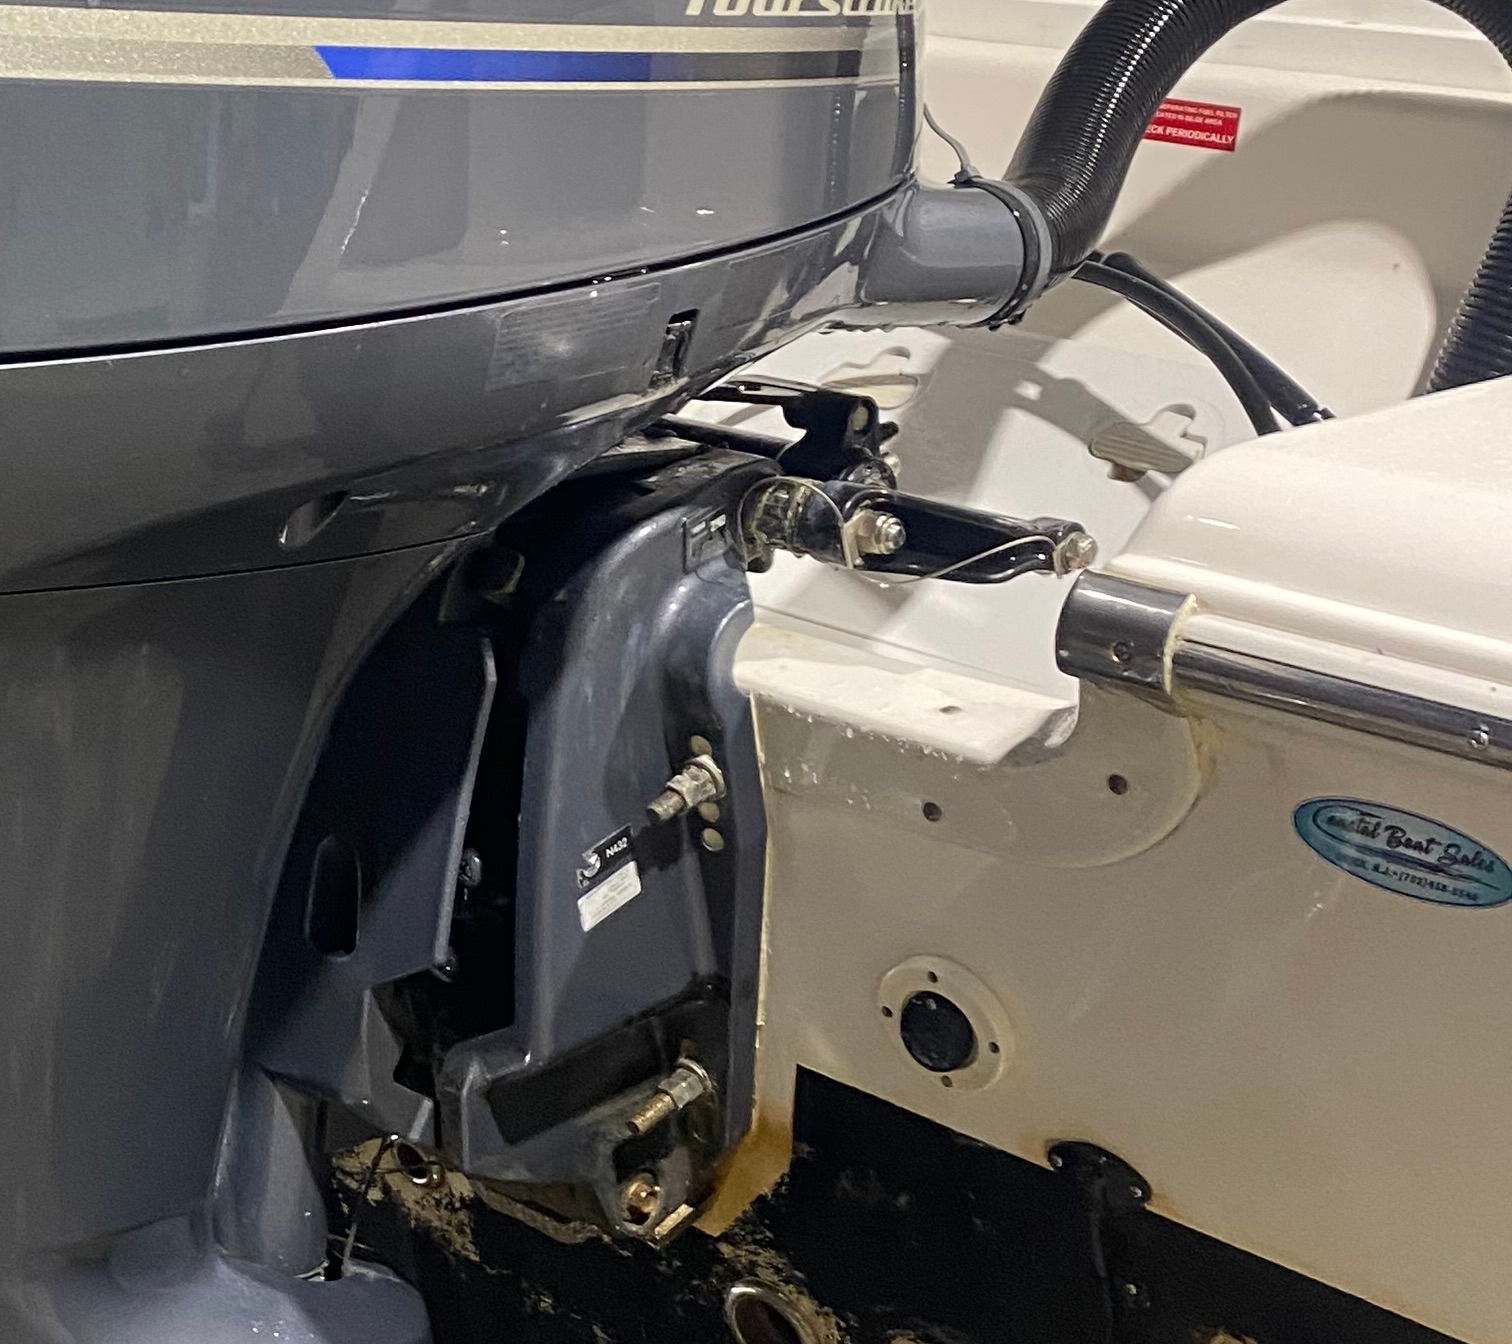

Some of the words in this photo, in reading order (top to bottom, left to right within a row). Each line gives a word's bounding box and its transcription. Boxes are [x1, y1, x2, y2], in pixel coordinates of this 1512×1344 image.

[1165, 125, 1235, 144] PERIODICALLY
[1383, 824, 1441, 855] Boat
[1437, 843, 1496, 874] Sales
